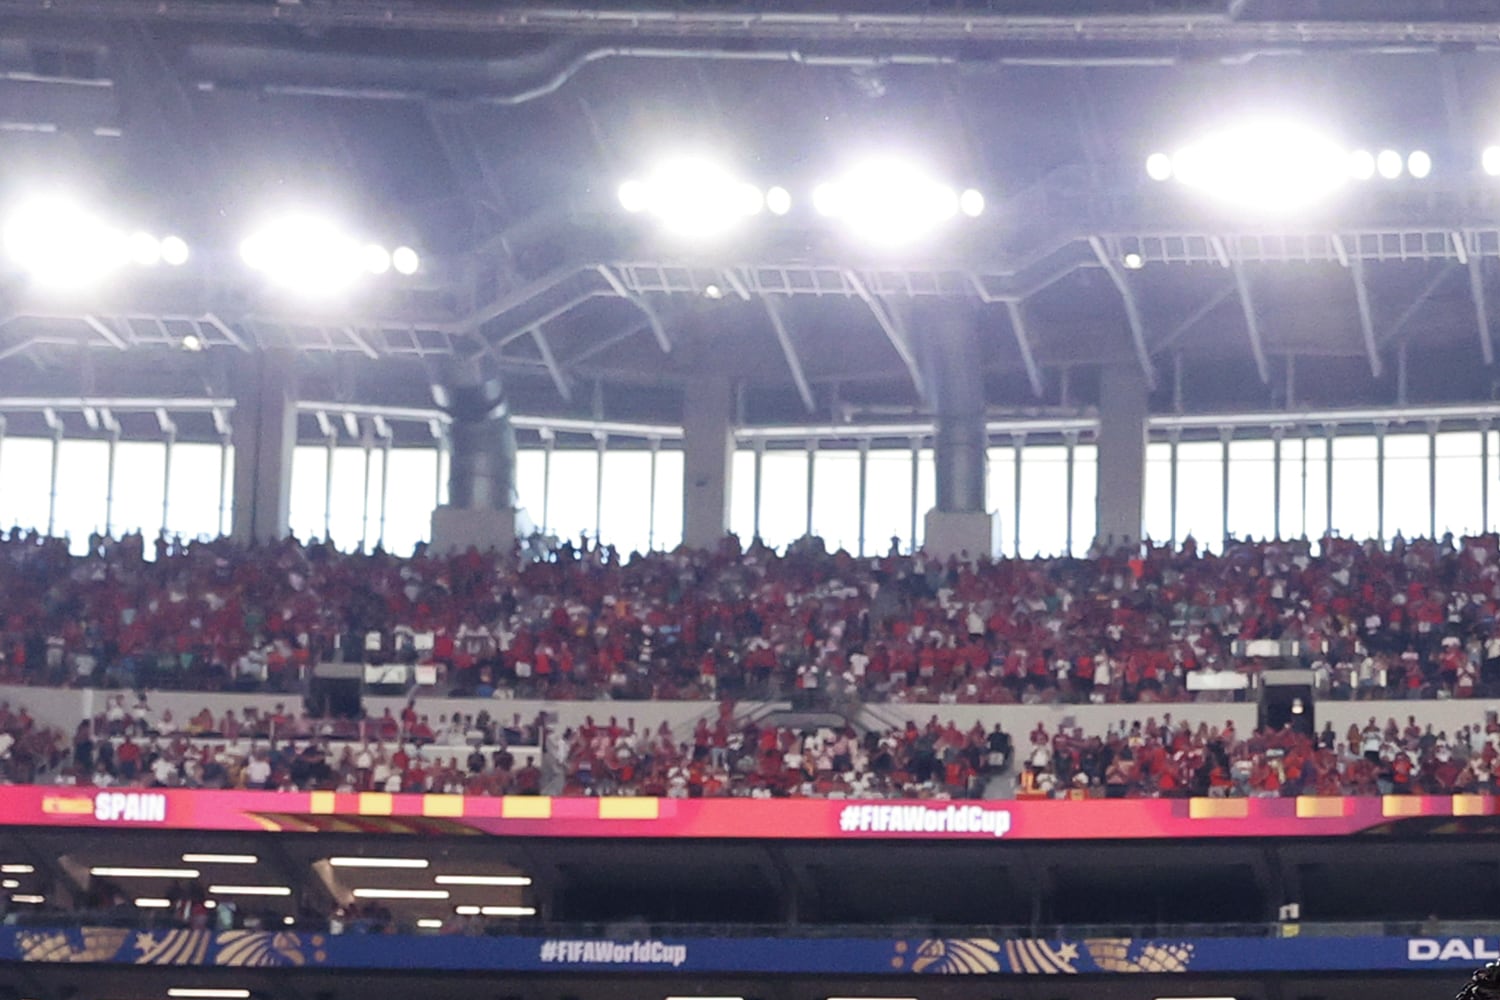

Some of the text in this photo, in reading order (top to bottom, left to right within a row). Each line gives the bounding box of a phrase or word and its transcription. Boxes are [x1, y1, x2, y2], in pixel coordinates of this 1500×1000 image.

[95, 793, 165, 821] SPAIN
[840, 804, 1010, 836] #FIFAWorldCup
[540, 940, 686, 966] #FIFAWorldCup
